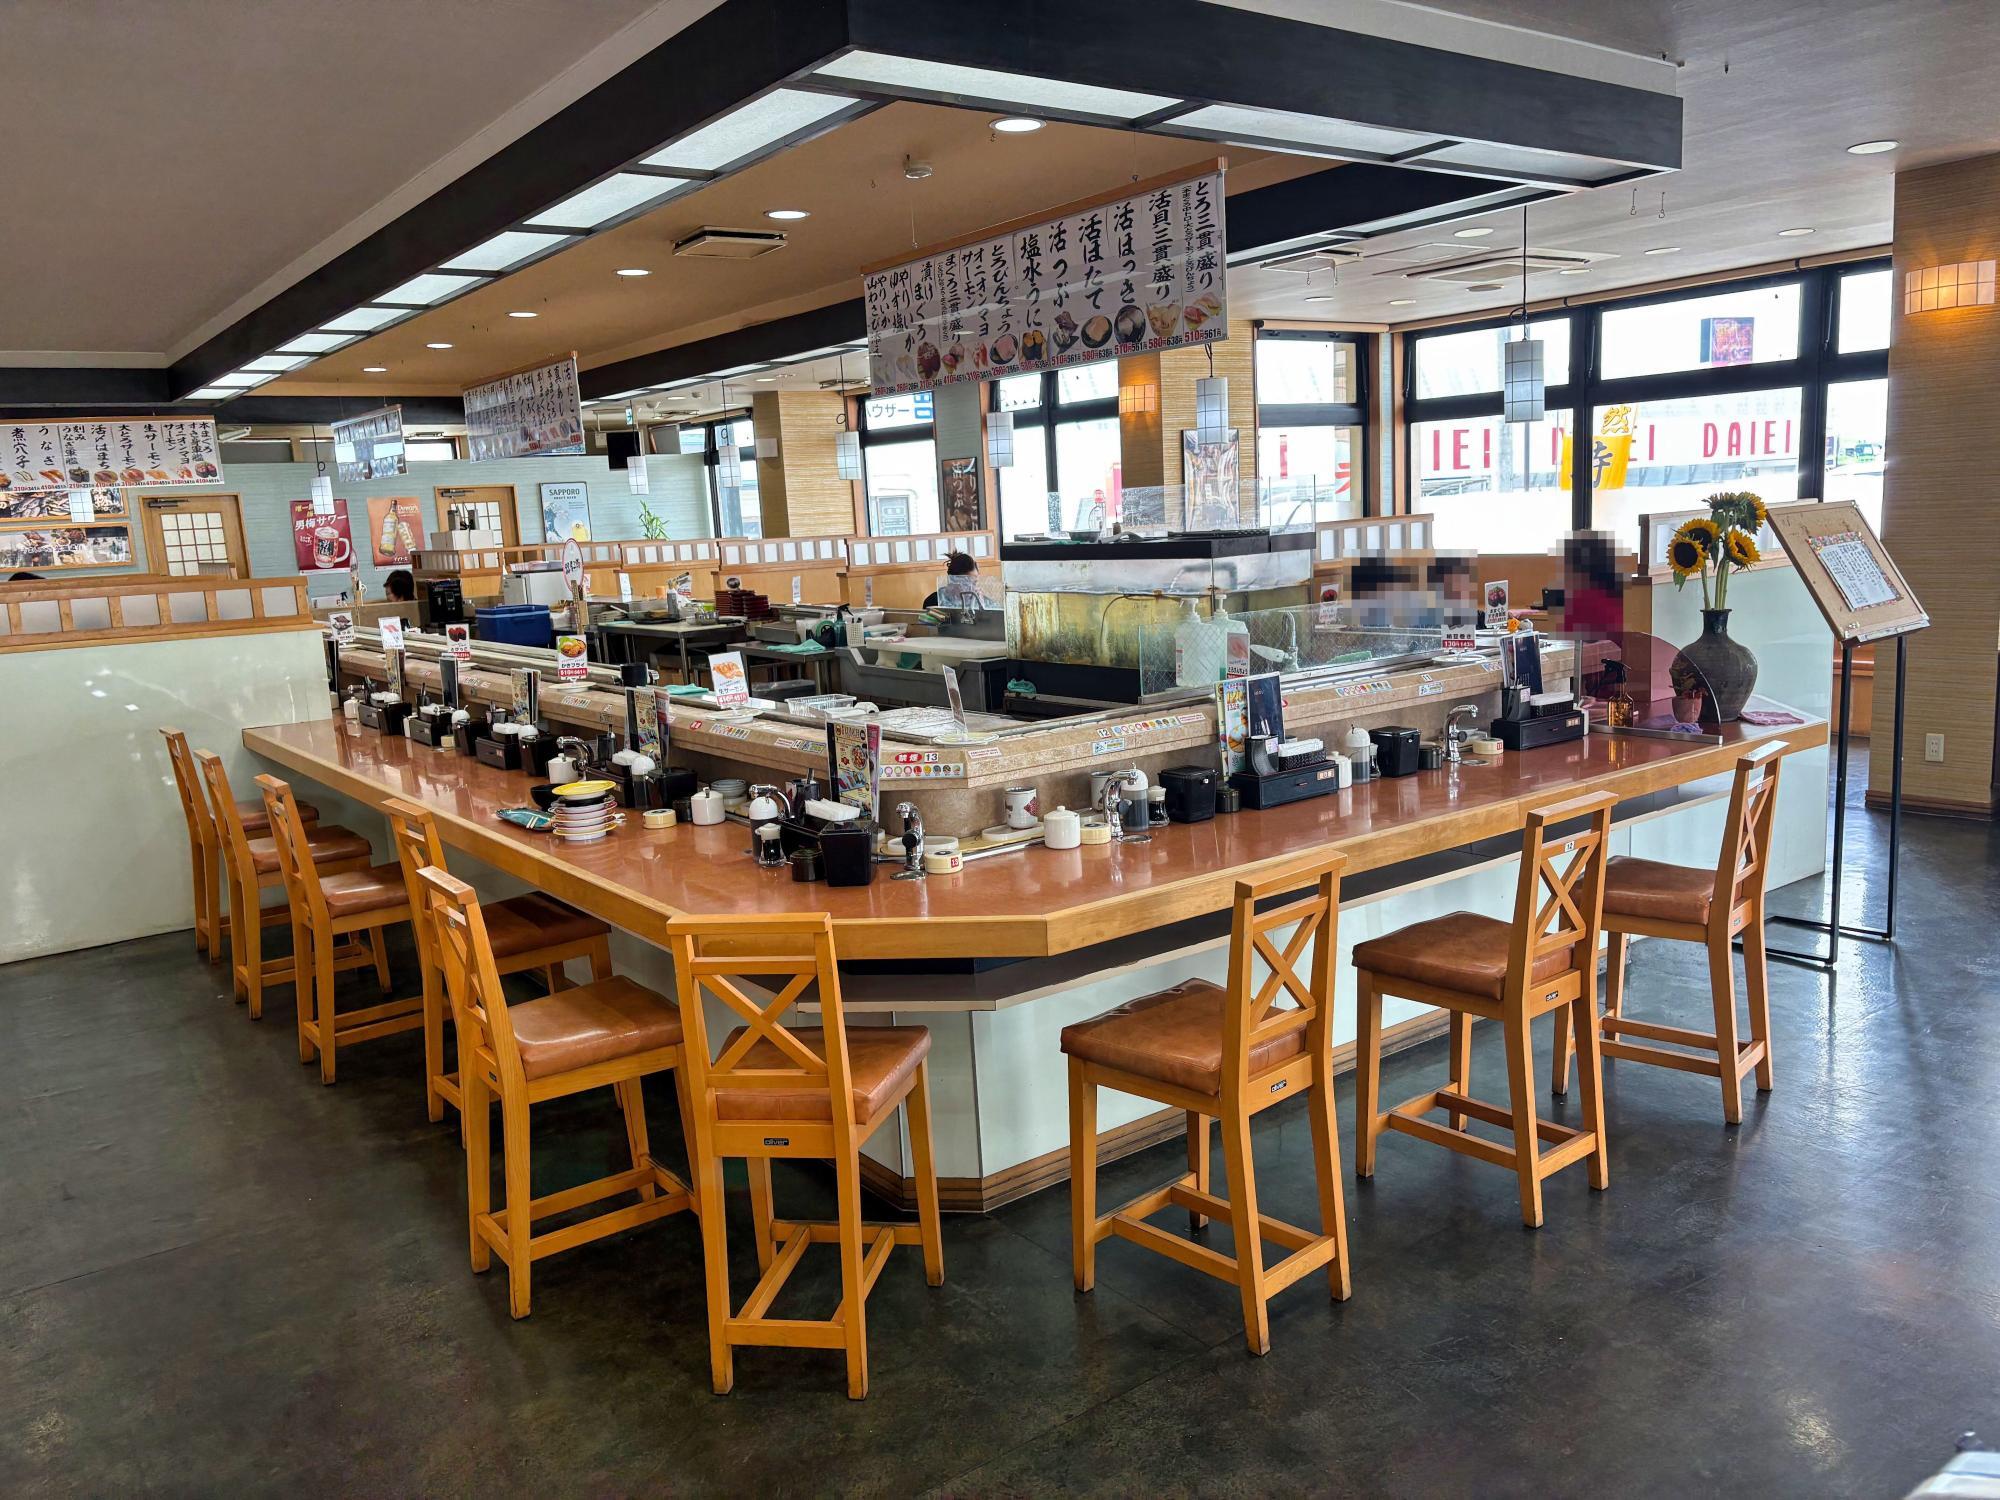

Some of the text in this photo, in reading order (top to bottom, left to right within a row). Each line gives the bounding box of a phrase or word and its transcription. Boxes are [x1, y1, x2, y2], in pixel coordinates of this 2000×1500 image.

[1113, 201, 1136, 303] 活ほっき
[1148, 190, 1175, 300] 活貝三貫盛り
[1194, 181, 1217, 290] とろ三貫盛り
[961, 250, 975, 309] サーモン
[1020, 234, 1042, 328] 塩水うに
[1048, 221, 1070, 308] 活つぶ
[1078, 213, 1104, 309] 活ほたて
[973, 247, 989, 337] オニオンマヨ
[991, 244, 1013, 334] とろびんちょう
[11, 427, 30, 468] 煮穴子
[39, 425, 55, 466] うなぎ
[119, 424, 136, 470] 大とろサーモン
[143, 424, 161, 469] 生サーモン
[163, 423, 177, 451] サーモン
[175, 423, 189, 465] オニオンマヨ
[1433, 429, 1490, 471] IEI
[1703, 420, 1791, 457] DAIEI
[549, 488, 580, 496] SAPPORO
[295, 514, 347, 531] 男梅サワー
[1099, 729, 1109, 737] 12
[925, 753, 938, 762] 13
